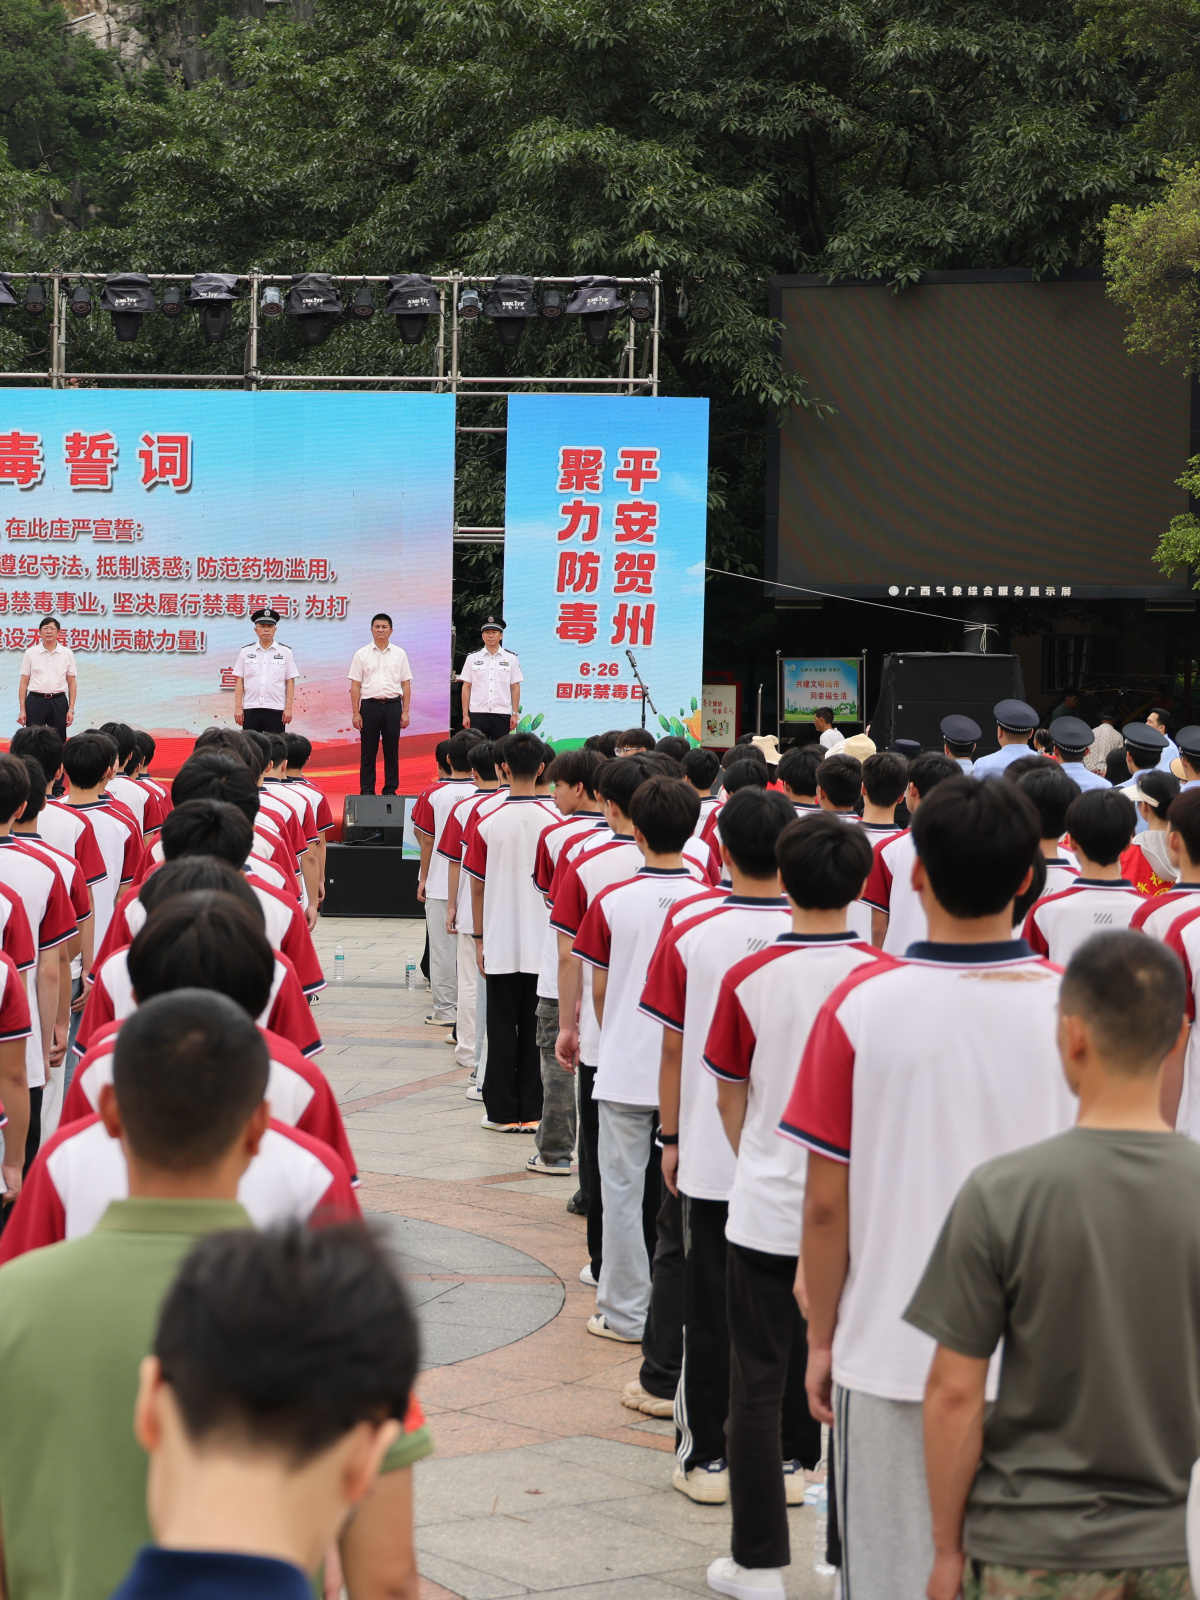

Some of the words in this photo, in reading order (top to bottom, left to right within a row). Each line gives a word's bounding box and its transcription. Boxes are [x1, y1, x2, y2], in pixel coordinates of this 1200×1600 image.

[556, 448, 604, 645] 聚力防毒
[611, 449, 658, 646] 平安贺州
[904, 585, 1072, 597] 广西气象综合服务显示屏
[556, 682, 646, 700] 国际禁毒日
[796, 680, 840, 688] 共建文明城市
[810, 692, 847, 700] 同幸福生活
